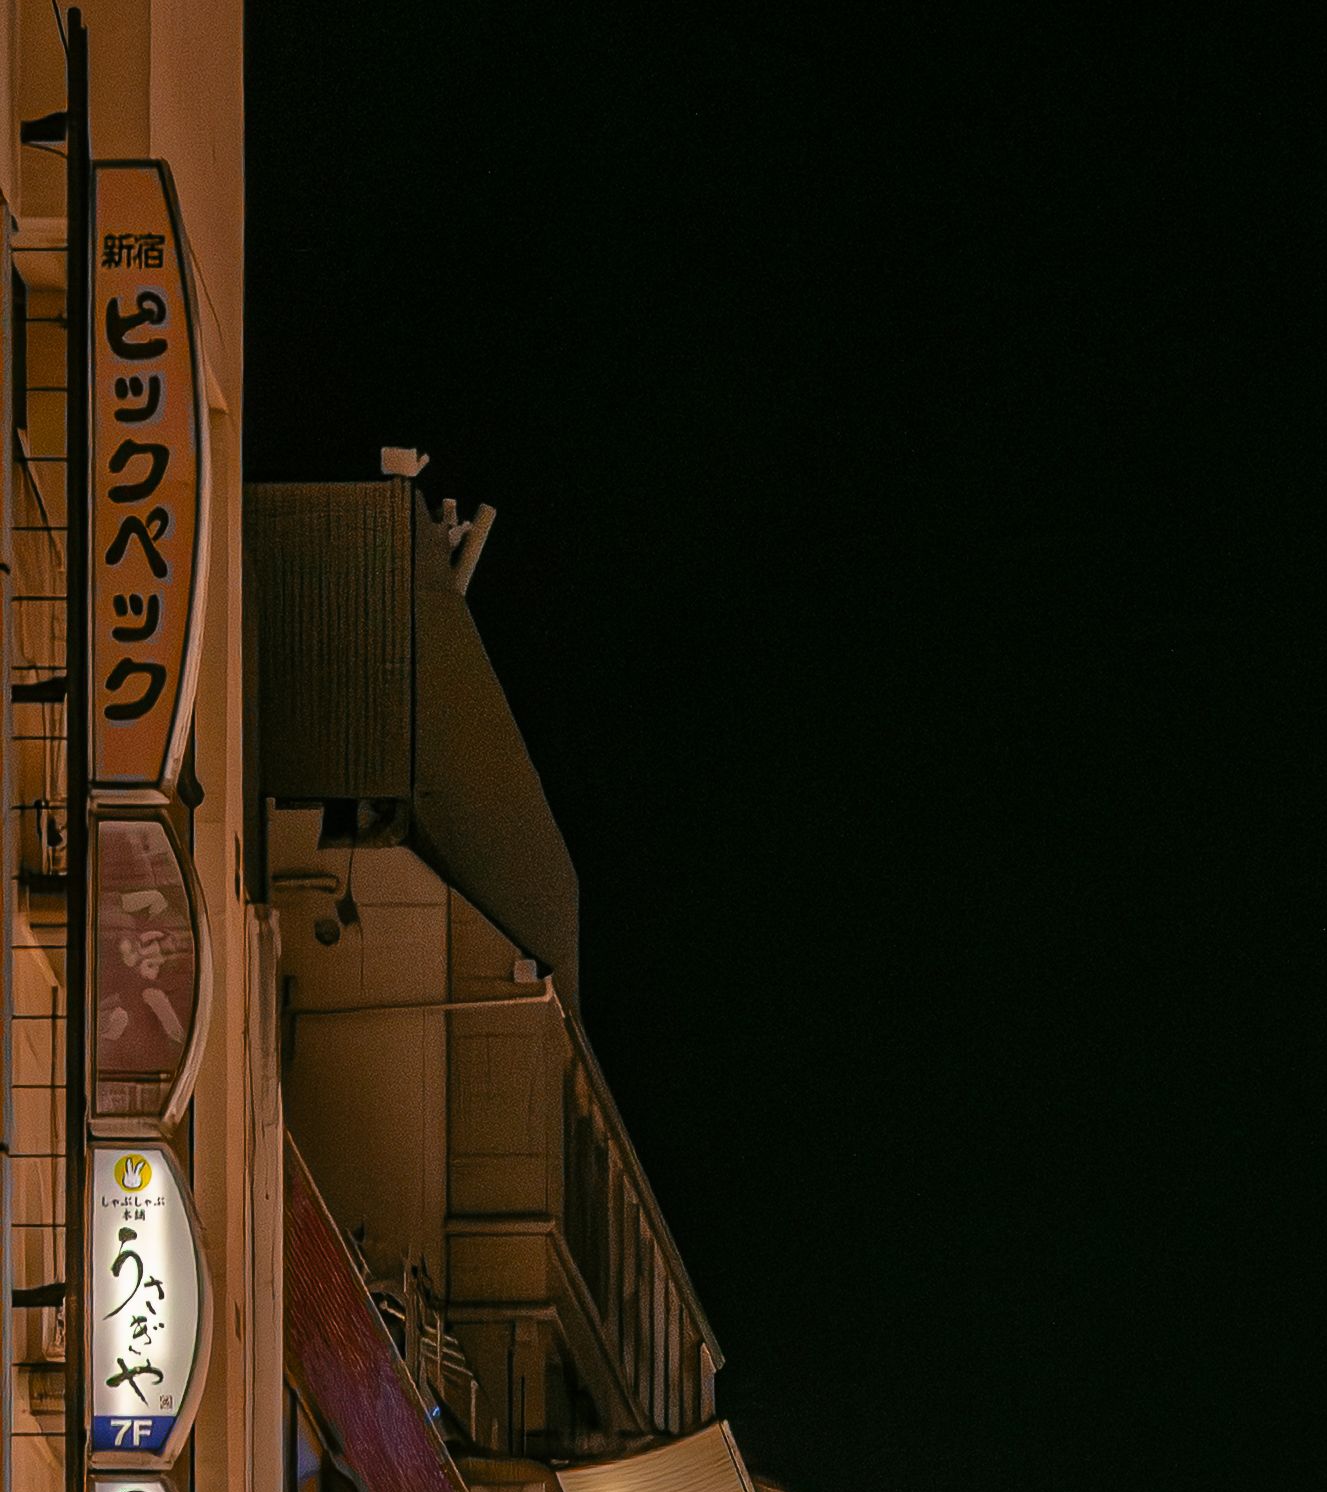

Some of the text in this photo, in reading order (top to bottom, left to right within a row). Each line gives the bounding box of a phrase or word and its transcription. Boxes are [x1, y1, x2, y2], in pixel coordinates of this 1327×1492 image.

[103, 233, 166, 271] 新宿
[105, 289, 169, 722] ピックペック
[103, 1228, 167, 1408] うさぎや
[109, 1418, 152, 1449] 7F
